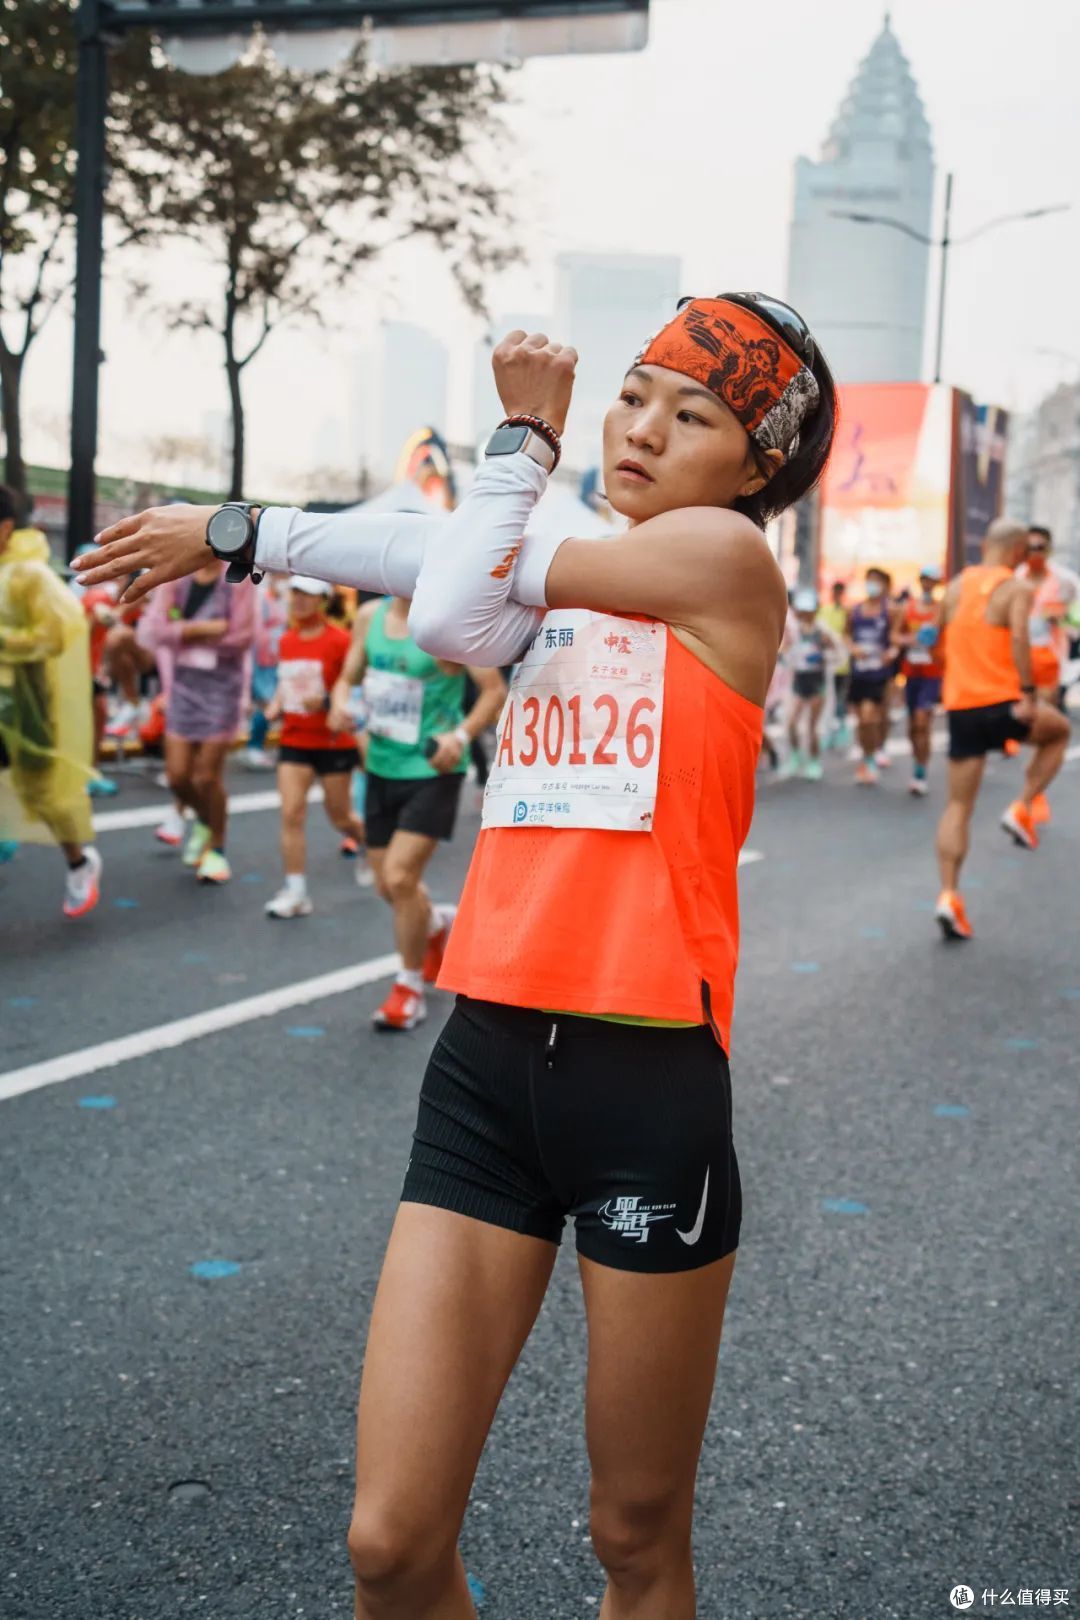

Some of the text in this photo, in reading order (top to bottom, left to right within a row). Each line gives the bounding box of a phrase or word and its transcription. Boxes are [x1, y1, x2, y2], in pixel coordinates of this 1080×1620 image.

[498, 693, 656, 768] A30126
[623, 783, 639, 793] A2
[529, 802, 571, 814] 太平洋保险
[529, 814, 545, 822] CPIC
